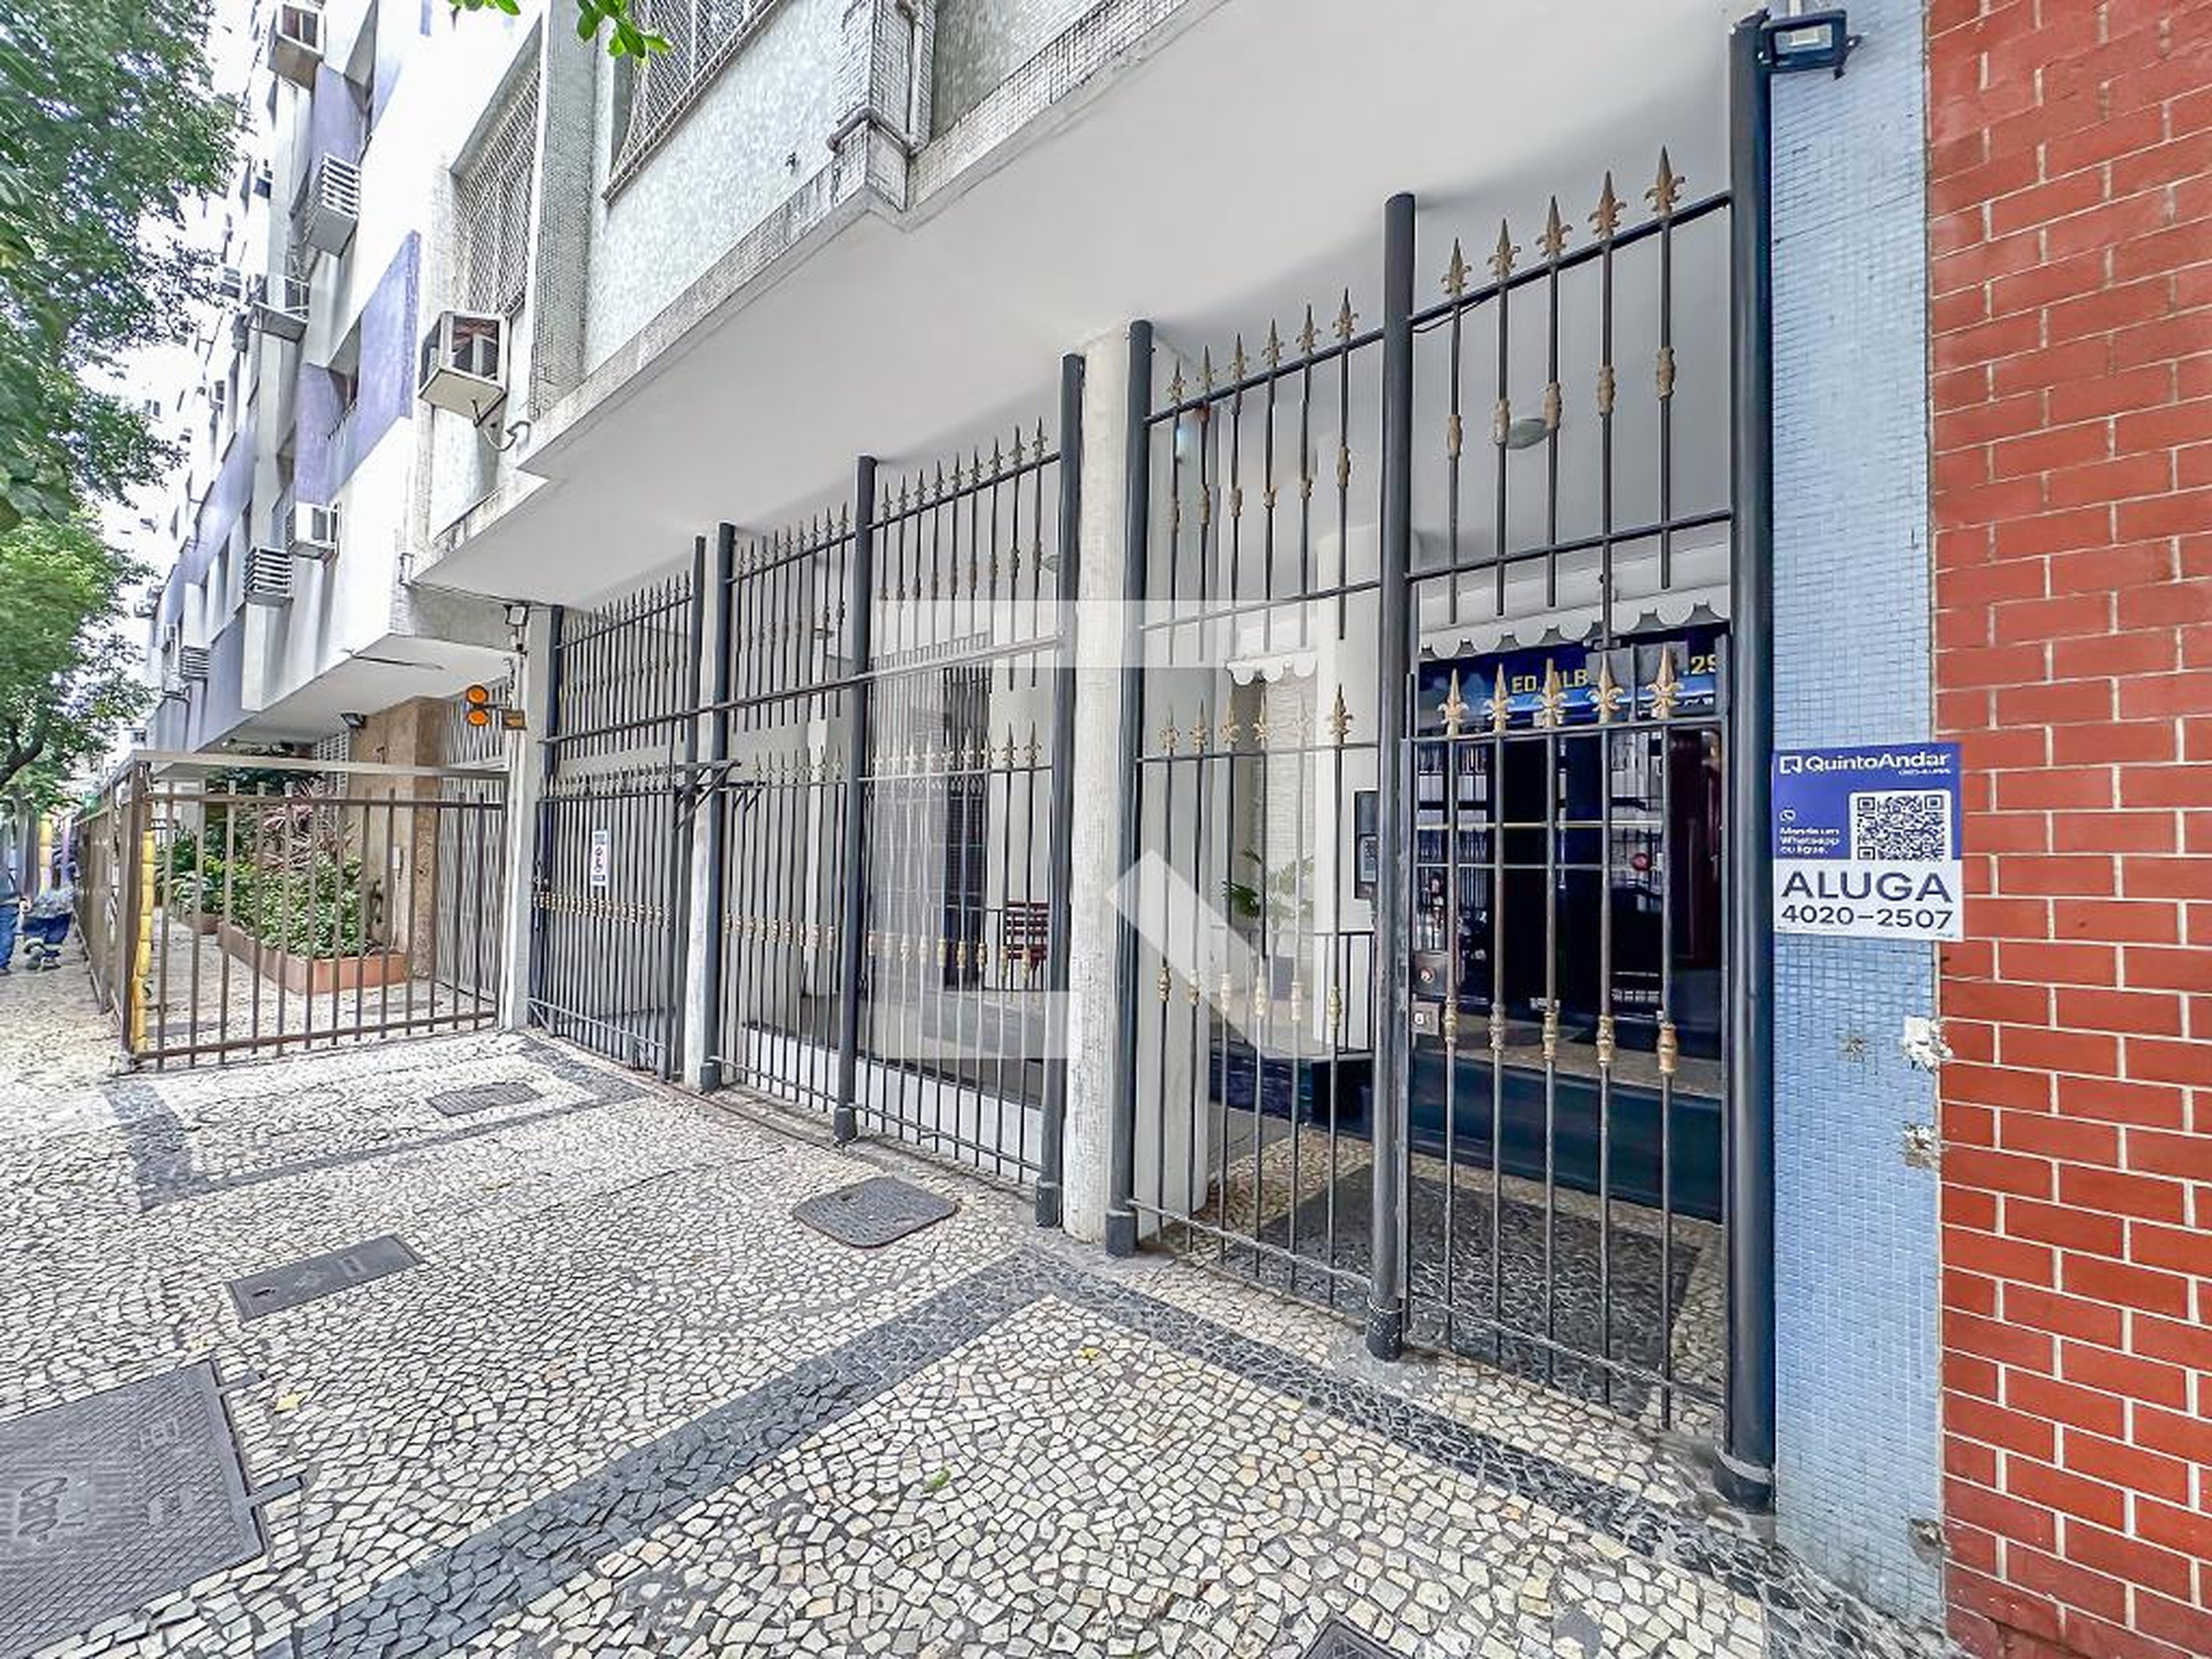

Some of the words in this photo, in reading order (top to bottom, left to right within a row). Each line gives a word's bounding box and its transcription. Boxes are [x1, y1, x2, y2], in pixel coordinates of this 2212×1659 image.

[1806, 752, 1951, 772] QuintoAndar
[1781, 871, 1952, 903] ALUGA
[1781, 905, 1953, 930] 4020-2507
